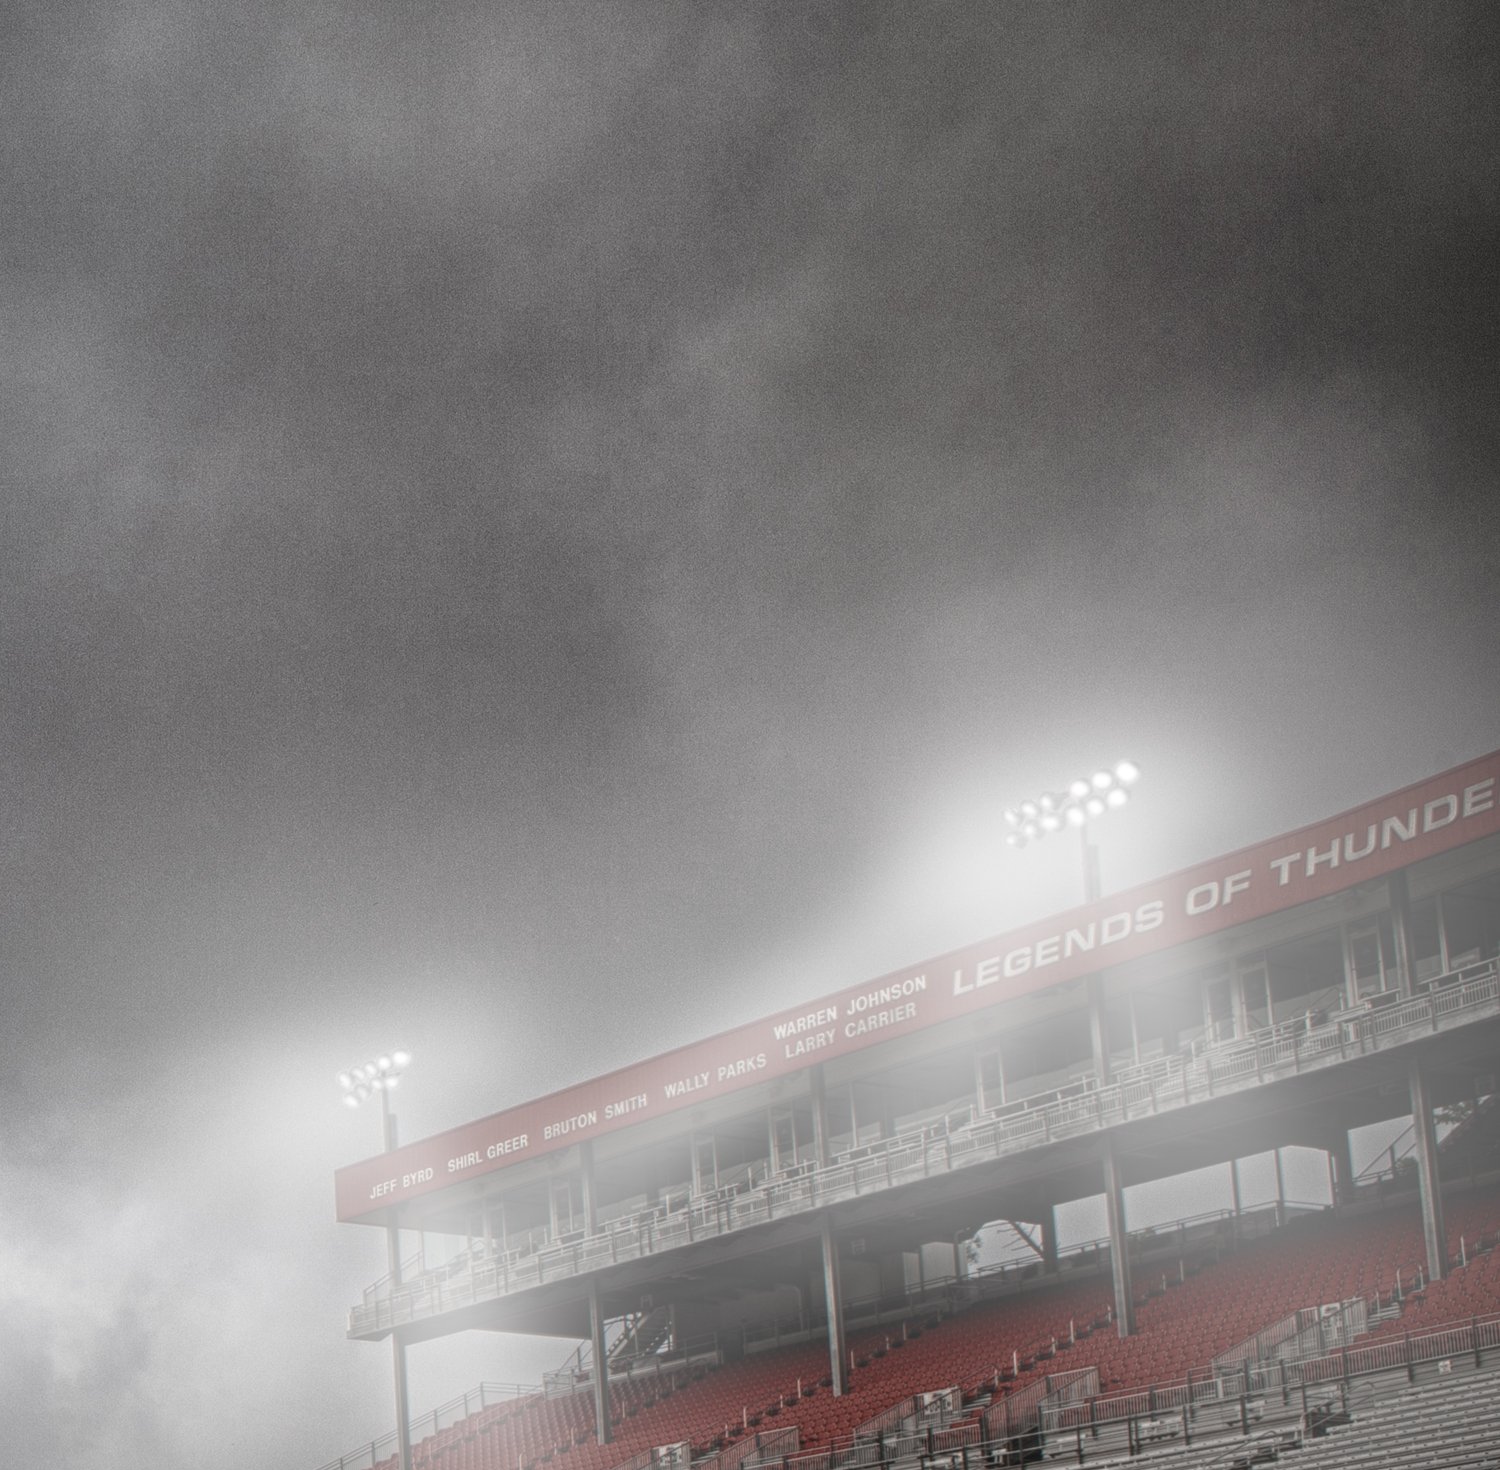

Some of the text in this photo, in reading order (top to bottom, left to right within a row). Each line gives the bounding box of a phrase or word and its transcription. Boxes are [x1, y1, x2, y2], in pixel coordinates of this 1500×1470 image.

[953, 900, 1165, 997] LEGENDS
[1185, 869, 1252, 917] OF
[773, 975, 927, 1040] WARREN JOHNSON
[785, 1002, 917, 1059] LARRY CARRIER
[664, 1053, 767, 1099] WALLY PARKS
[544, 1093, 648, 1140] BRUTON SMITH
[447, 1134, 529, 1173] SHIRL GREER
[370, 1167, 433, 1199] JEFF BYRD
